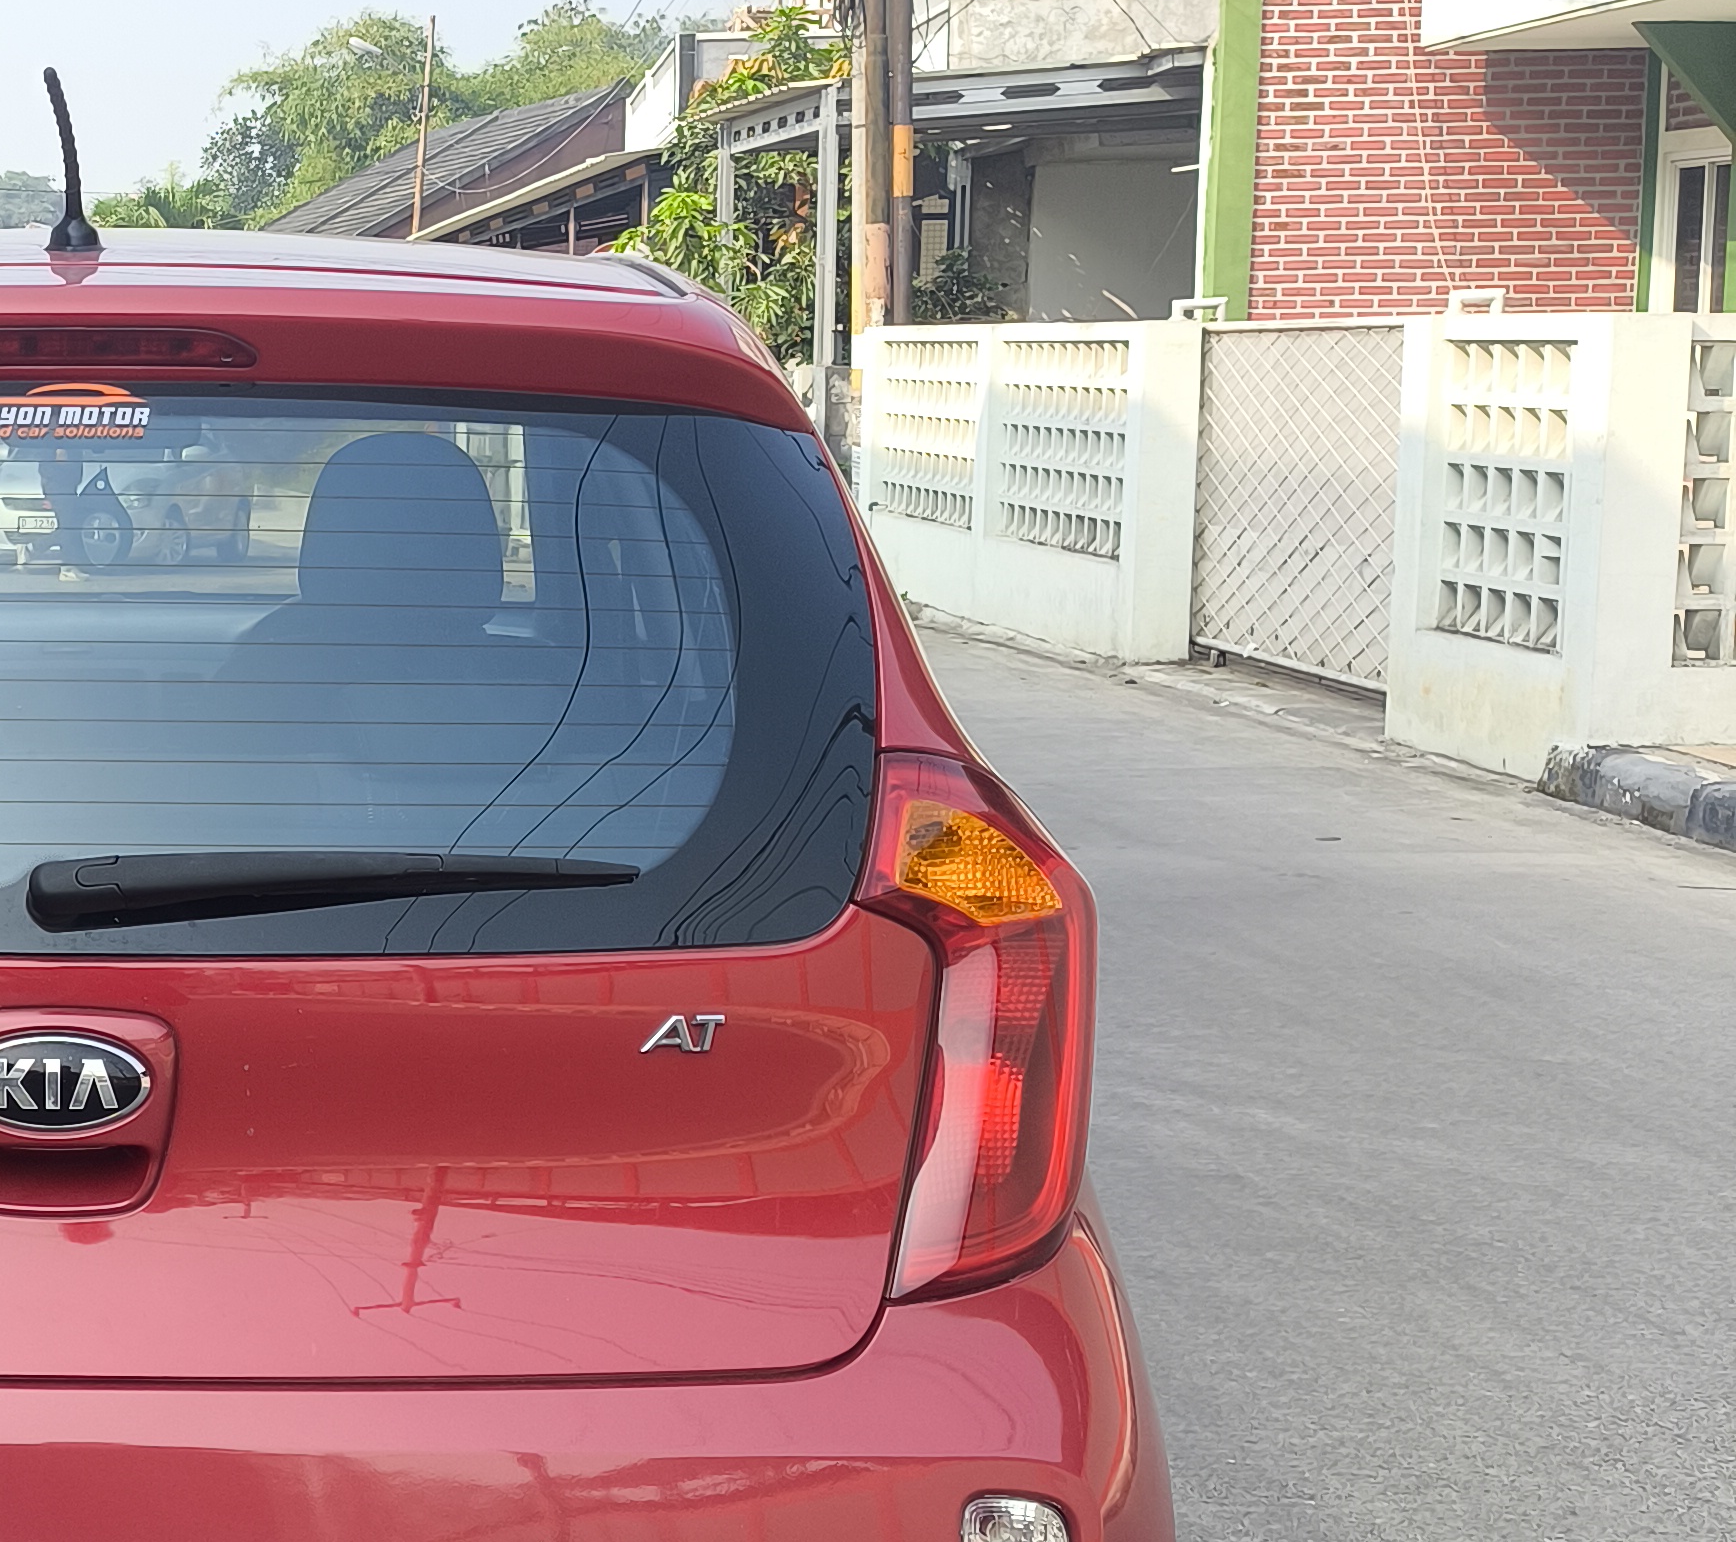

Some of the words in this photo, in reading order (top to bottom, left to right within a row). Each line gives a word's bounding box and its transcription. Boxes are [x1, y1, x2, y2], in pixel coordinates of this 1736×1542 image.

[58, 406, 151, 426] MOTOR
[17, 427, 50, 438] car
[54, 425, 146, 439] solutions
[638, 1014, 726, 1053] AT
